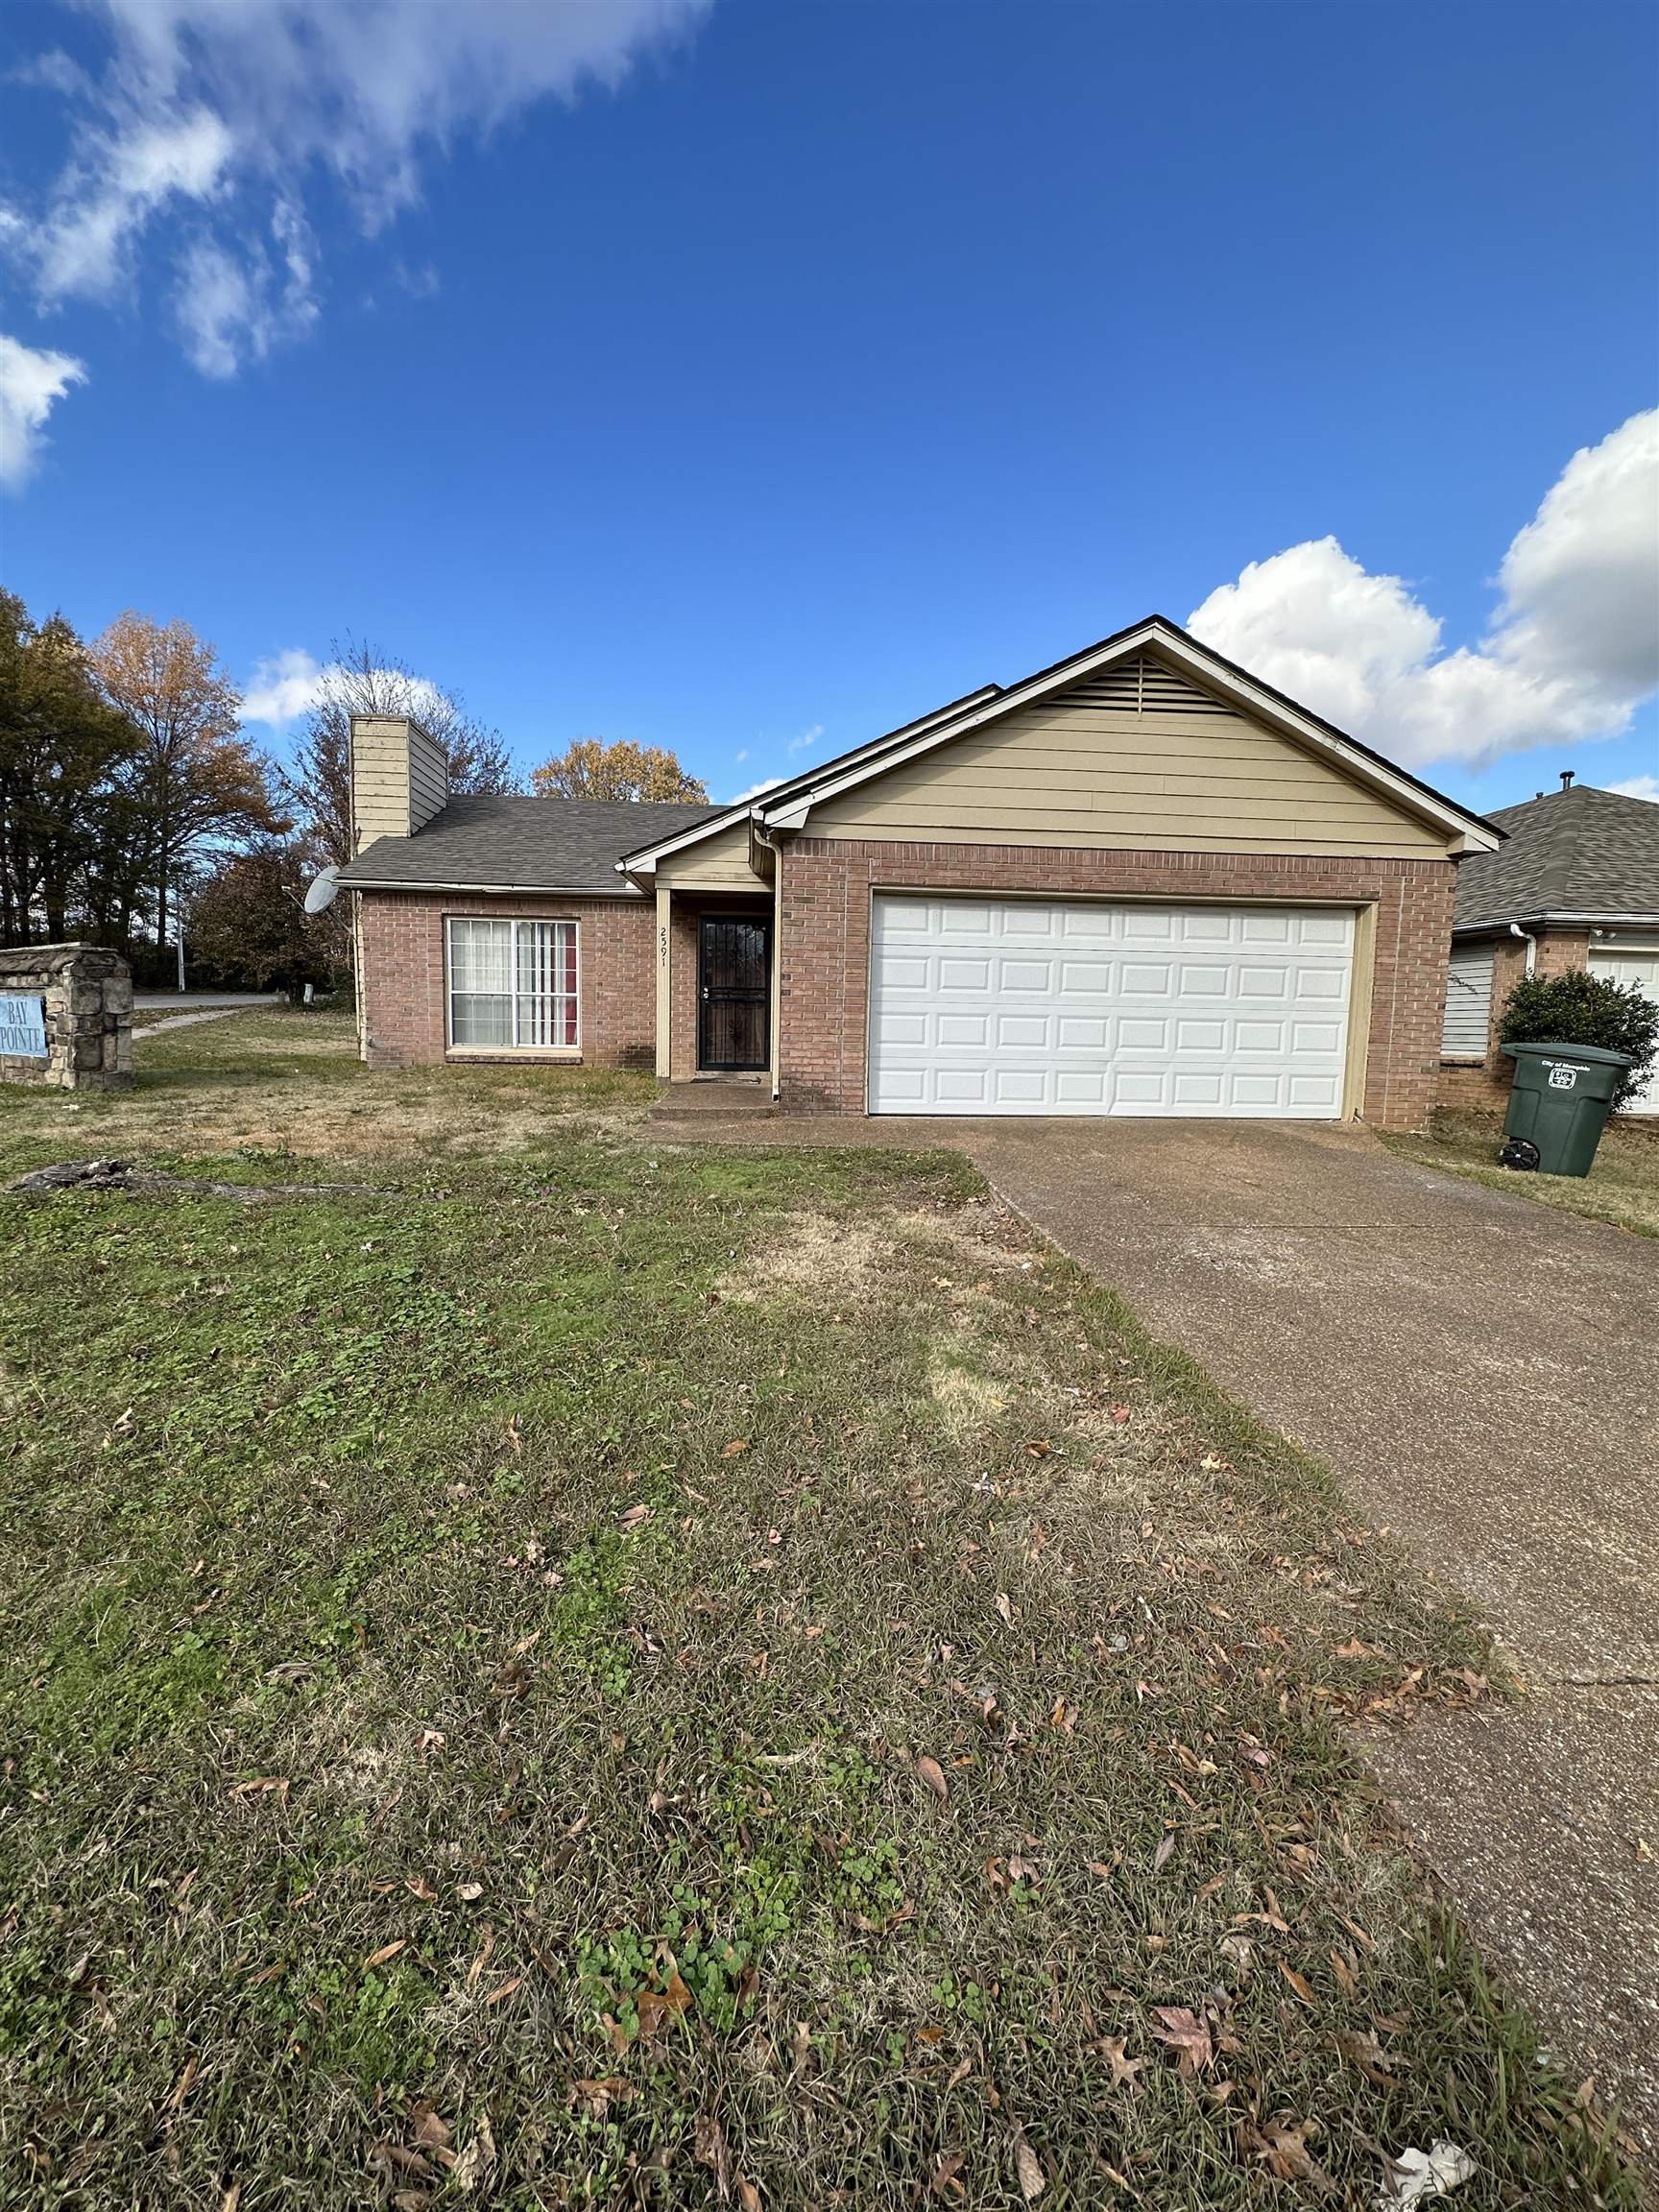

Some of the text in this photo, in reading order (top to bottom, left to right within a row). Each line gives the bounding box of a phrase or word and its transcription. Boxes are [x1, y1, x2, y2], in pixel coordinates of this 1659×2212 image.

[8, 1001, 27, 1024] BAY
[0, 1026, 41, 1051] POINTE
[1541, 1059, 1554, 1068] City
